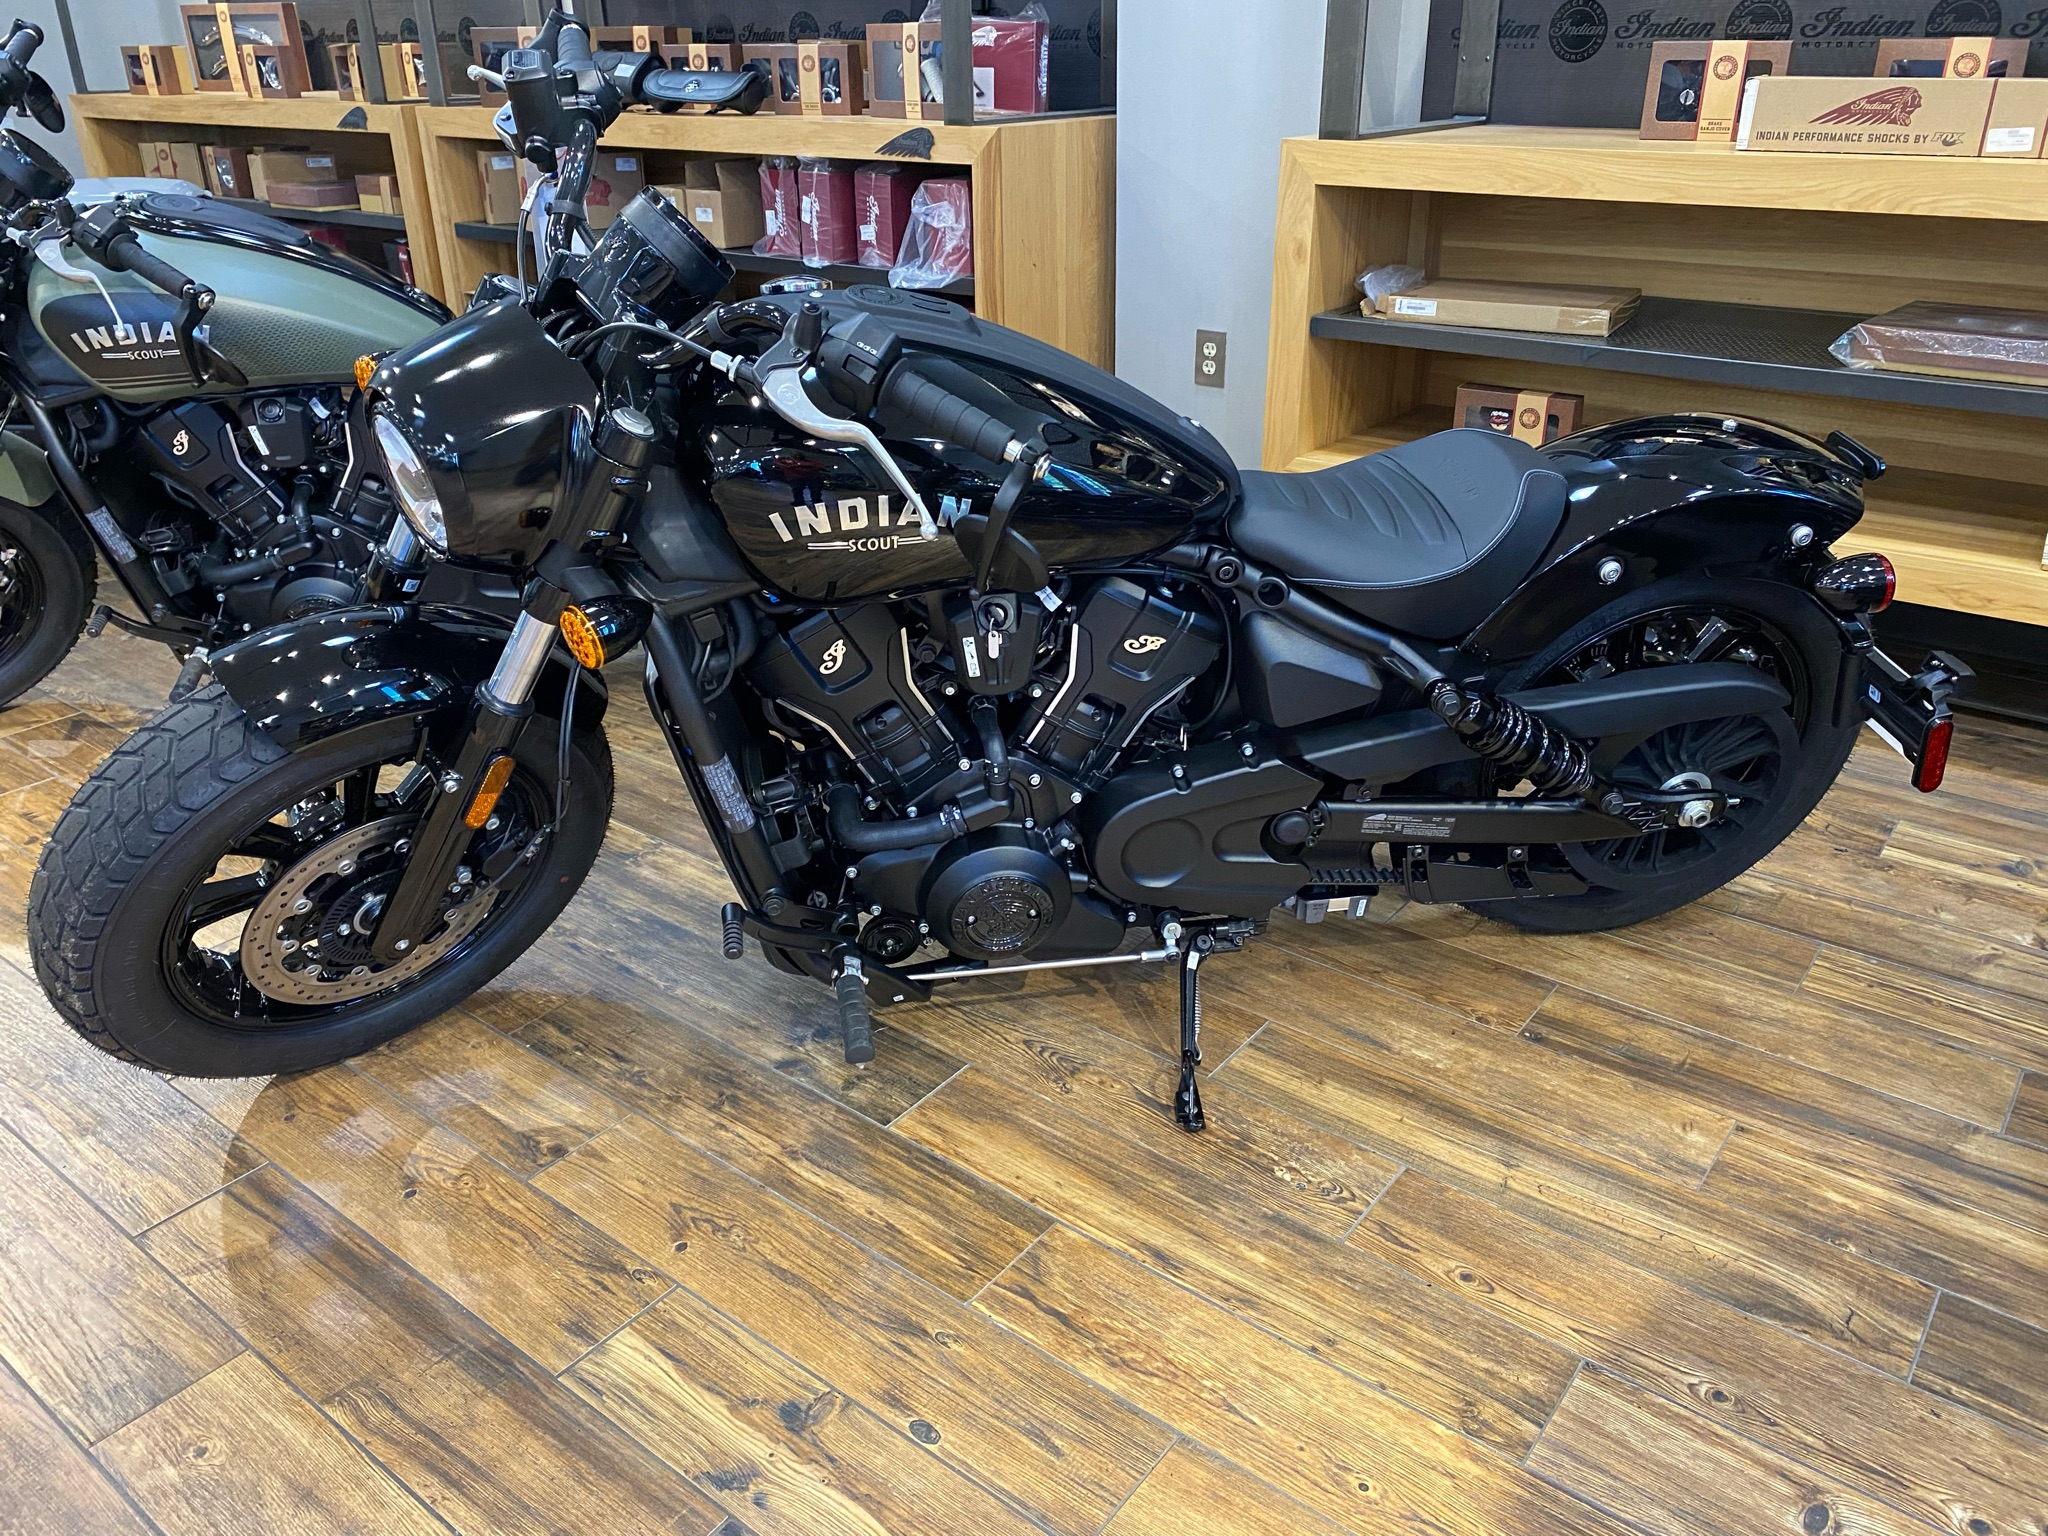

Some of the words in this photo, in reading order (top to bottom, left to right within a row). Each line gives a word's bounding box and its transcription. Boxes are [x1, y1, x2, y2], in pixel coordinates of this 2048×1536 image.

[1550, 19, 1605, 37] Indian
[1614, 9, 1716, 39] Indian
[1727, 16, 1790, 34] Indian
[1800, 7, 1915, 38] Indian
[1927, 14, 1999, 32] Indian
[738, 22, 786, 42] Indian
[1851, 99, 1892, 110] Indian
[1756, 131, 1789, 141] INDIAN
[1792, 132, 1863, 143] PERFORMANCE
[1867, 133, 1910, 144] SHOCKS
[1914, 134, 1929, 144] BY
[1931, 131, 1966, 147] FOX
[127, 349, 164, 361] SCOUT
[848, 535, 900, 552] SCOUT
